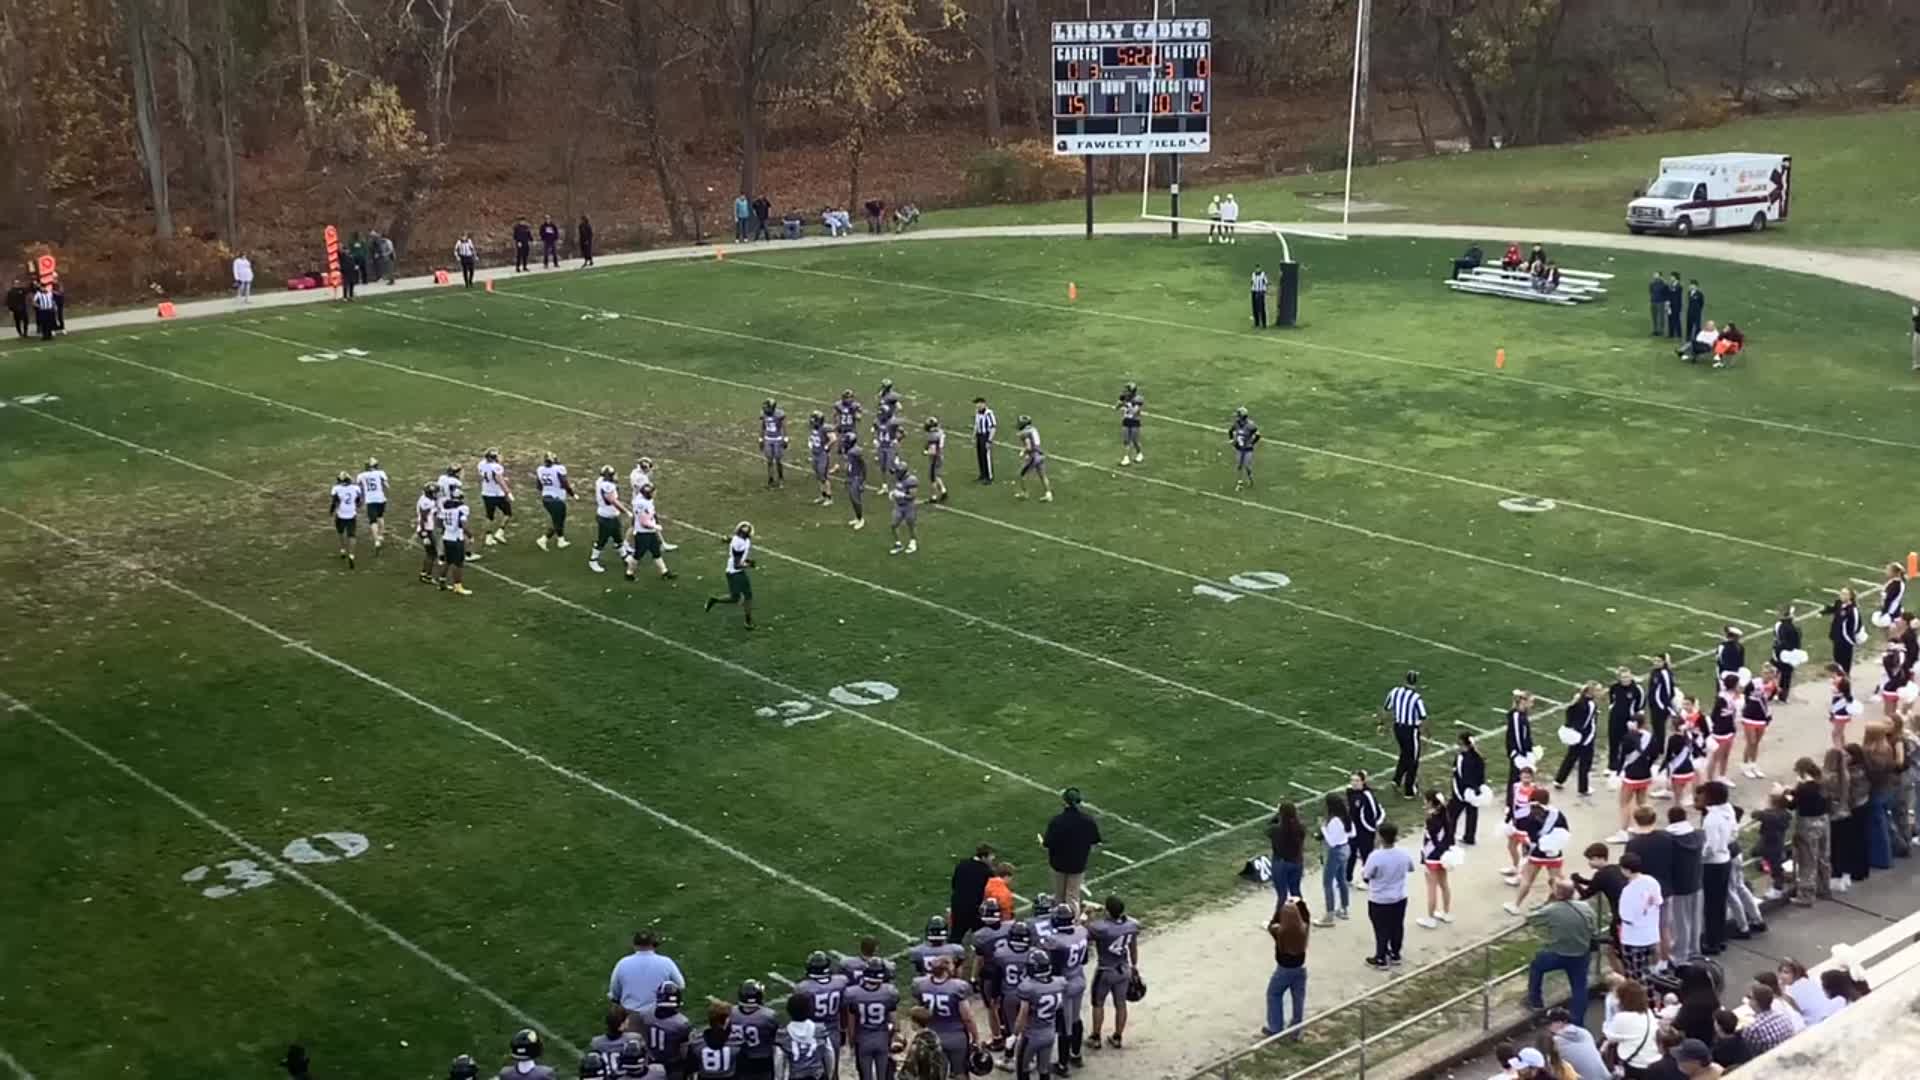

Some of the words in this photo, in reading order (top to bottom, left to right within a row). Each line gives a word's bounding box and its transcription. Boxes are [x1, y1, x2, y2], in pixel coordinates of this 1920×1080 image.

[1055, 23, 1124, 40] LINSLY
[1133, 22, 1208, 39] CADETS
[1057, 47, 1098, 61] CADETS
[1164, 45, 1207, 59] GUESTS
[1067, 61, 1079, 79] 0
[1089, 64, 1099, 79] 3
[1164, 62, 1174, 79] 3
[1196, 58, 1208, 78] 0
[1068, 95, 1085, 114] 15
[1154, 94, 1171, 113] 10
[1190, 93, 1202, 112] 2
[1077, 140, 1143, 150] FAWCETT
[344, 492, 352, 505] 2
[1193, 570, 1291, 602] 10
[755, 680, 899, 728] 20
[182, 831, 370, 899] 30
[813, 990, 841, 1017] 50
[921, 993, 951, 1017] 75
[858, 1002, 886, 1025] 19
[650, 1026, 665, 1051] 11
[701, 1046, 731, 1071] 81
